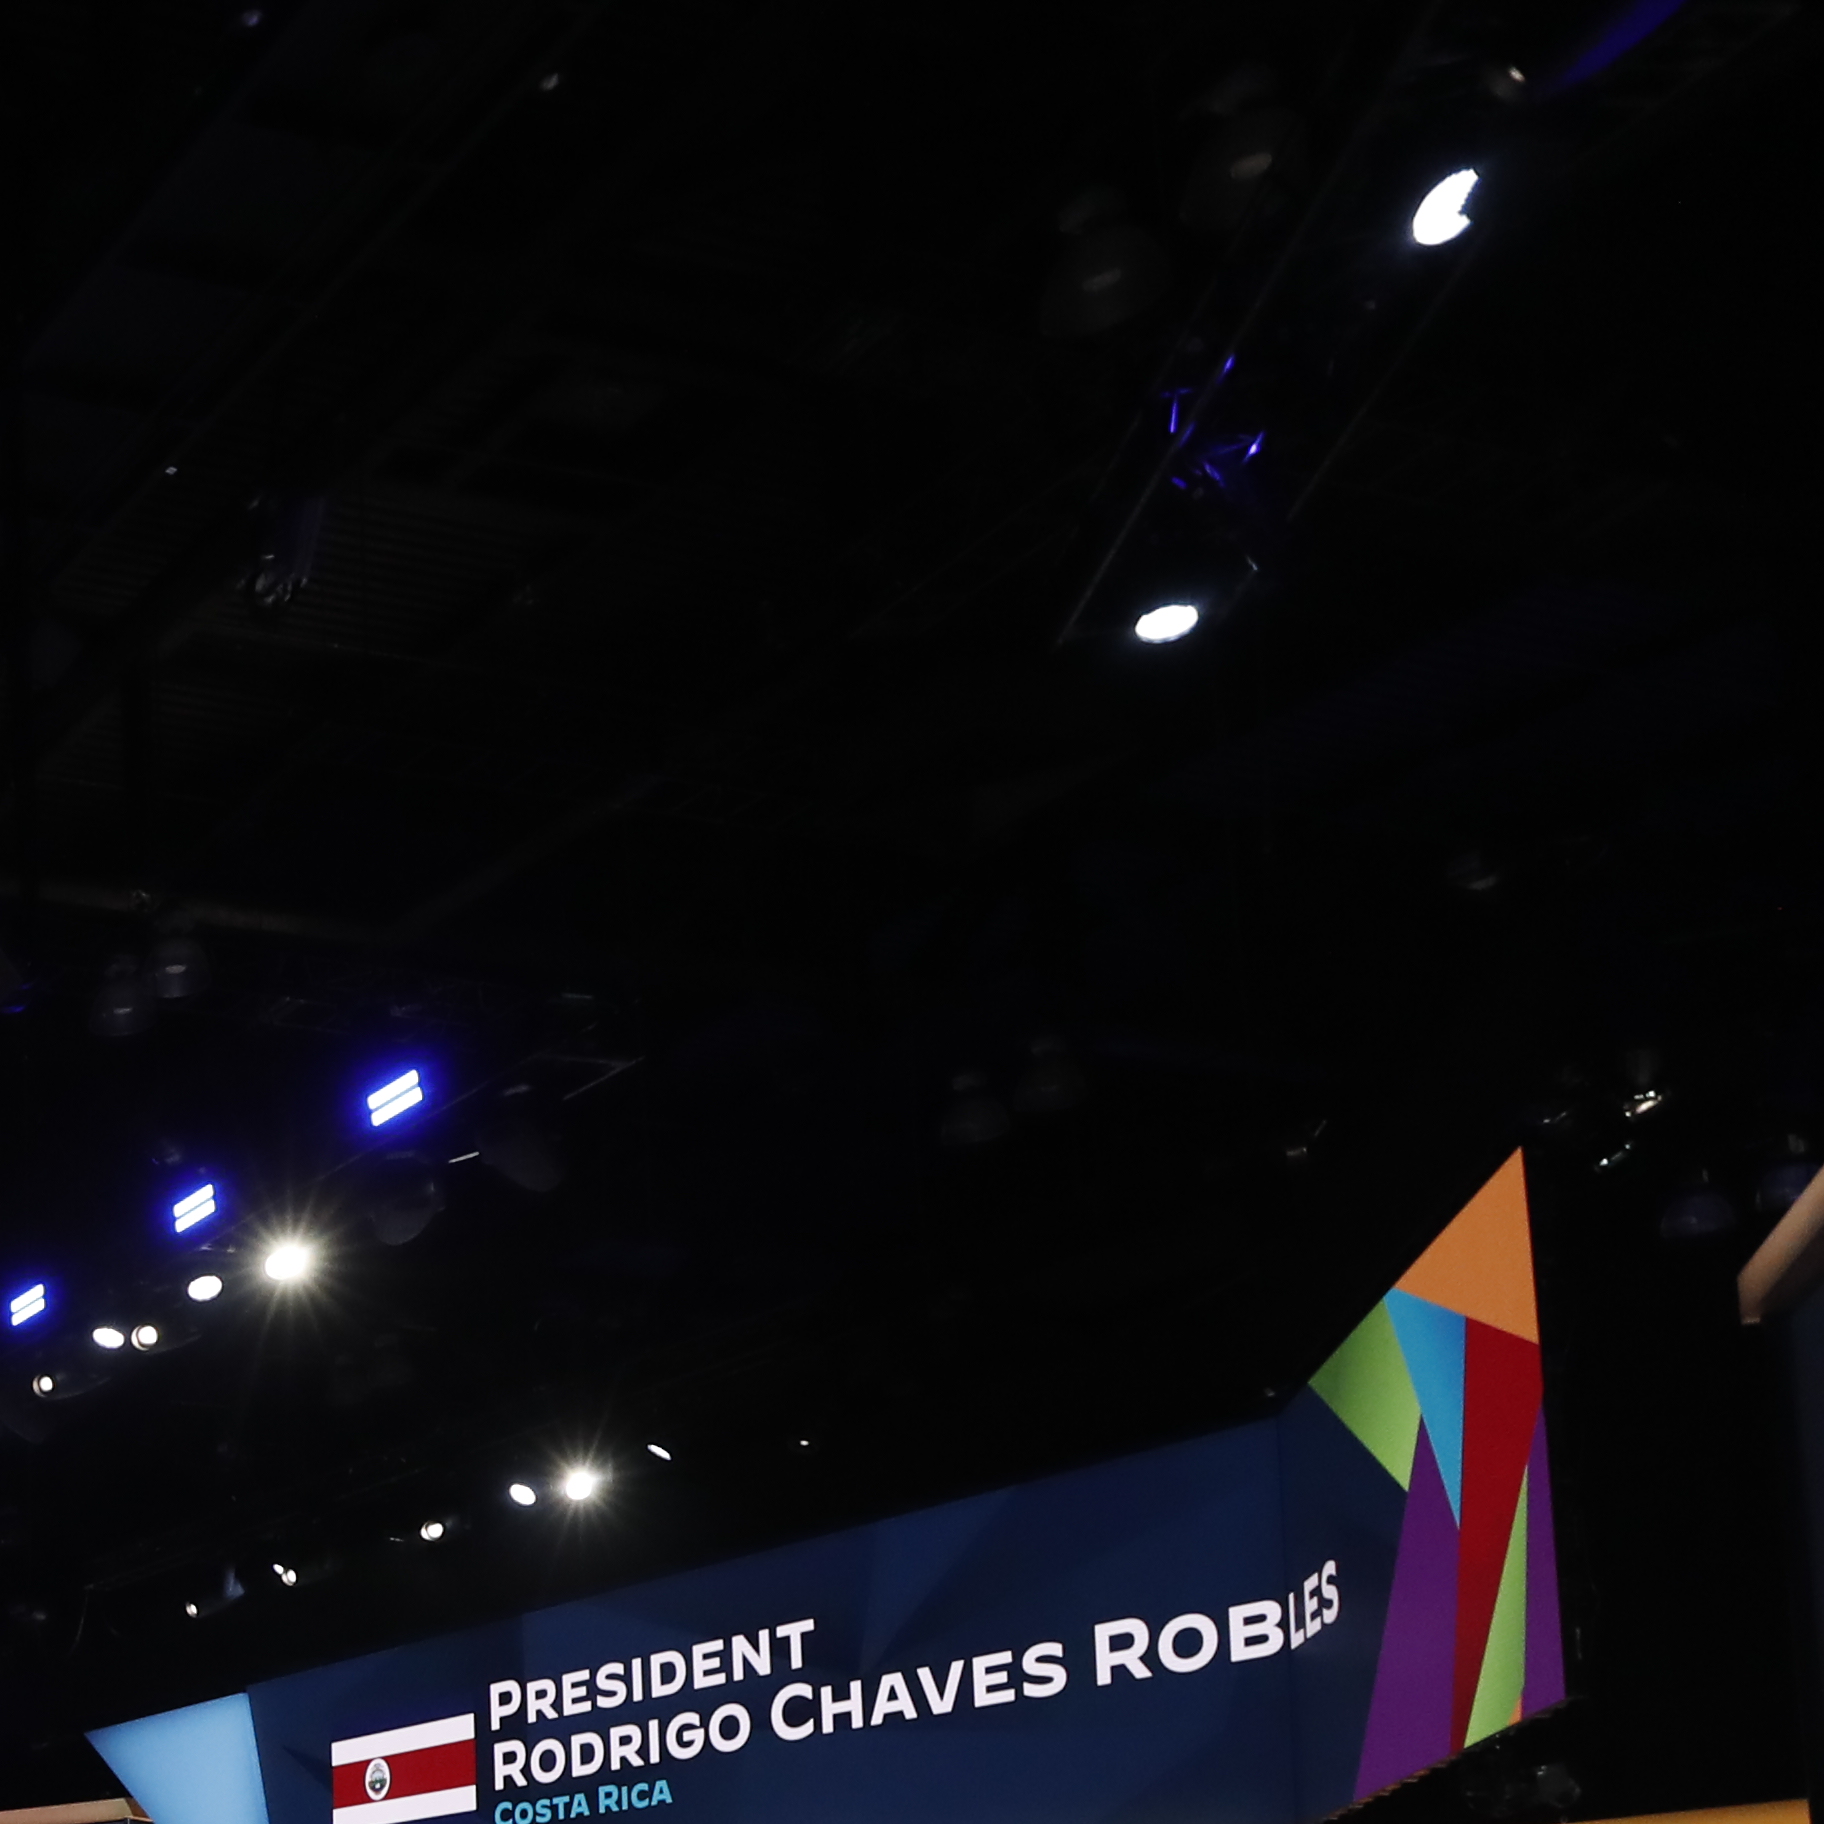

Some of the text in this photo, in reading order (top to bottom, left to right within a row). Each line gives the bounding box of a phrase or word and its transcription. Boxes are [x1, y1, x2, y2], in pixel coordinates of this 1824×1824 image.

[489, 1618, 818, 1731] PRESIDENT
[493, 1559, 1340, 1791] RODRIGO CHAVES ROBLES
[597, 1779, 673, 1813] RICA
